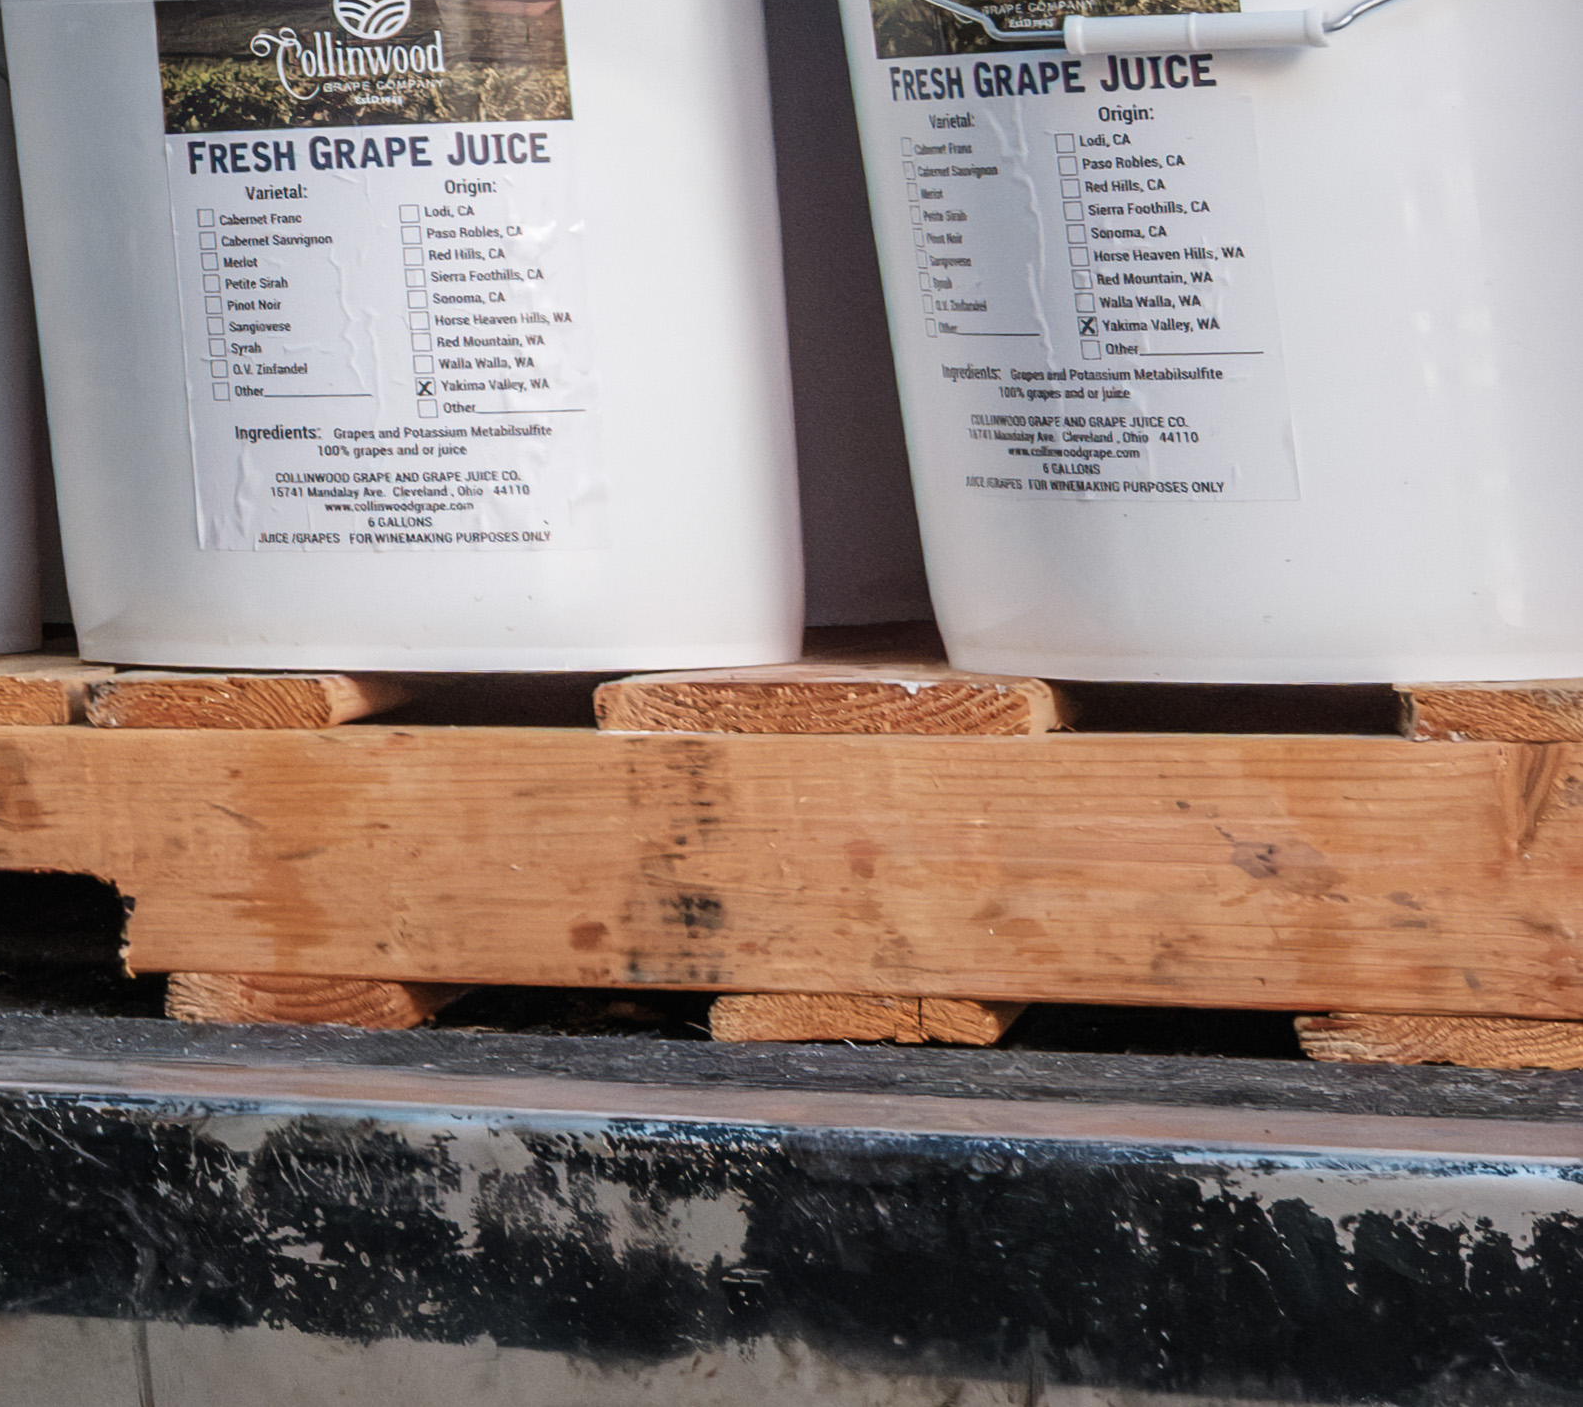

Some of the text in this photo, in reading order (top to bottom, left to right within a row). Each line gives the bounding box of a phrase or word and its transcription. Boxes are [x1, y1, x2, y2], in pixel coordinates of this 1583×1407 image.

[250, 27, 445, 100] Collinwood
[889, 54, 1217, 102] FRESH GRAPE JUICE
[1098, 104, 1154, 125] Origin:
[1079, 134, 1131, 148] Lodi, CA
[188, 132, 551, 174] FRESH GRAPE JUICE
[1082, 155, 1185, 169] Paso Robles, CA
[245, 184, 308, 200] Varietal:
[444, 178, 497, 197] Origin:
[1085, 178, 1166, 193] Red Hills, CA
[458, 205, 475, 216] CA
[1088, 204, 1124, 216] Sierra
[1191, 200, 1210, 212] CA
[270, 213, 302, 224] Franc
[427, 226, 523, 239] Paso Robles, CA
[1091, 225, 1167, 239] Sonoma, CA
[222, 233, 333, 247] Cabernet Sauvignon
[429, 249, 451, 261] Red
[489, 248, 506, 259] CA
[1133, 249, 1180, 260] Heaven
[1221, 247, 1245, 258] WA
[431, 271, 466, 282] Sierra
[527, 269, 544, 280] CA
[1097, 271, 1214, 285] Red Mountain, WA
[227, 298, 281, 311] Pinot Noir
[433, 292, 505, 304] Sonoma, CA
[1099, 296, 1133, 308] Walla
[1178, 295, 1201, 307] WA
[435, 315, 469, 326] Horse
[473, 314, 517, 325] Heaven
[553, 312, 572, 323] WA
[1102, 317, 1220, 332] Yakima Valley, WA
[229, 321, 291, 334] Sangiovese
[437, 335, 545, 348] Red Mountain, WA
[231, 342, 262, 356] Syrah
[1105, 343, 1138, 355] Other
[439, 357, 535, 370] Walla Walla, WA
[235, 385, 264, 397] Other
[440, 379, 550, 393] Yakima Valley, WA
[443, 401, 476, 413] Other
[1089, 416, 1127, 427] GRAPE
[235, 425, 321, 443] Ingredients:
[333, 428, 374, 441] Grapes
[379, 427, 400, 438] and
[404, 426, 467, 438] Potassium
[1159, 432, 1199, 443] 44110
[318, 444, 468, 459] 100% grapes and or juice
[276, 473, 350, 484] COLLINWOOD
[353, 473, 390, 483] GRAPE
[395, 473, 419, 482] AND
[423, 472, 461, 482] GRAPE
[464, 471, 498, 481] JUICE
[307, 487, 359, 499] Mandalay
[393, 486, 447, 498] Cleveland
[457, 485, 484, 496] Ohio
[494, 484, 530, 495] 44110
[1124, 482, 1224, 493] PURPOSES ONLY
[368, 517, 433, 528] 6 GALLONS
[349, 534, 373, 544] FOR
[375, 533, 452, 544] WINEMAKING
[456, 532, 519, 543] PURPOSES
[522, 531, 551, 542] ONLY
